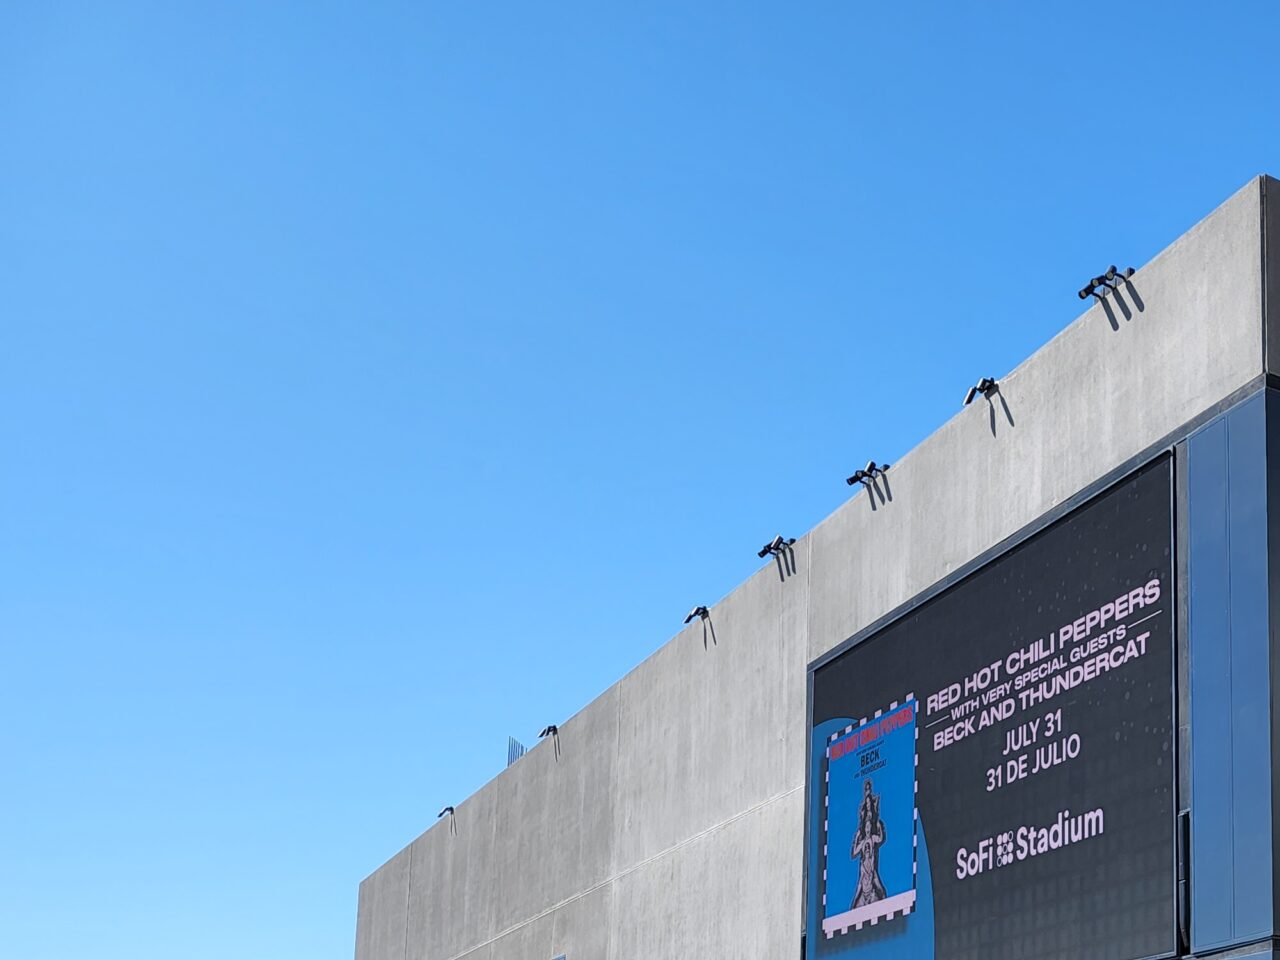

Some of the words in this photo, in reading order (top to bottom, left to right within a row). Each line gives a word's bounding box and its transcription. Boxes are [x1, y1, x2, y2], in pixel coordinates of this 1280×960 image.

[926, 683, 962, 716] RED
[964, 659, 1003, 697] HOT
[1005, 632, 1055, 675] CHILI
[1059, 579, 1161, 650] PEPPERS
[950, 697, 980, 721] WITH
[982, 680, 1012, 706] VERY
[1014, 655, 1067, 691] SPECIAL
[1069, 624, 1127, 662] GUESTS
[933, 714, 976, 751] BECK
[978, 698, 1016, 731] AND
[1018, 632, 1151, 711] THUNDERCAT
[860, 748, 880, 767] BECK
[985, 764, 1002, 792] 31
[1006, 754, 1028, 784] DE
[1031, 733, 1081, 774] JULIO
[1002, 717, 1041, 756] JULY
[1045, 709, 1063, 737] 31
[956, 836, 995, 880] SoFi
[1016, 808, 1104, 861] Stadium
